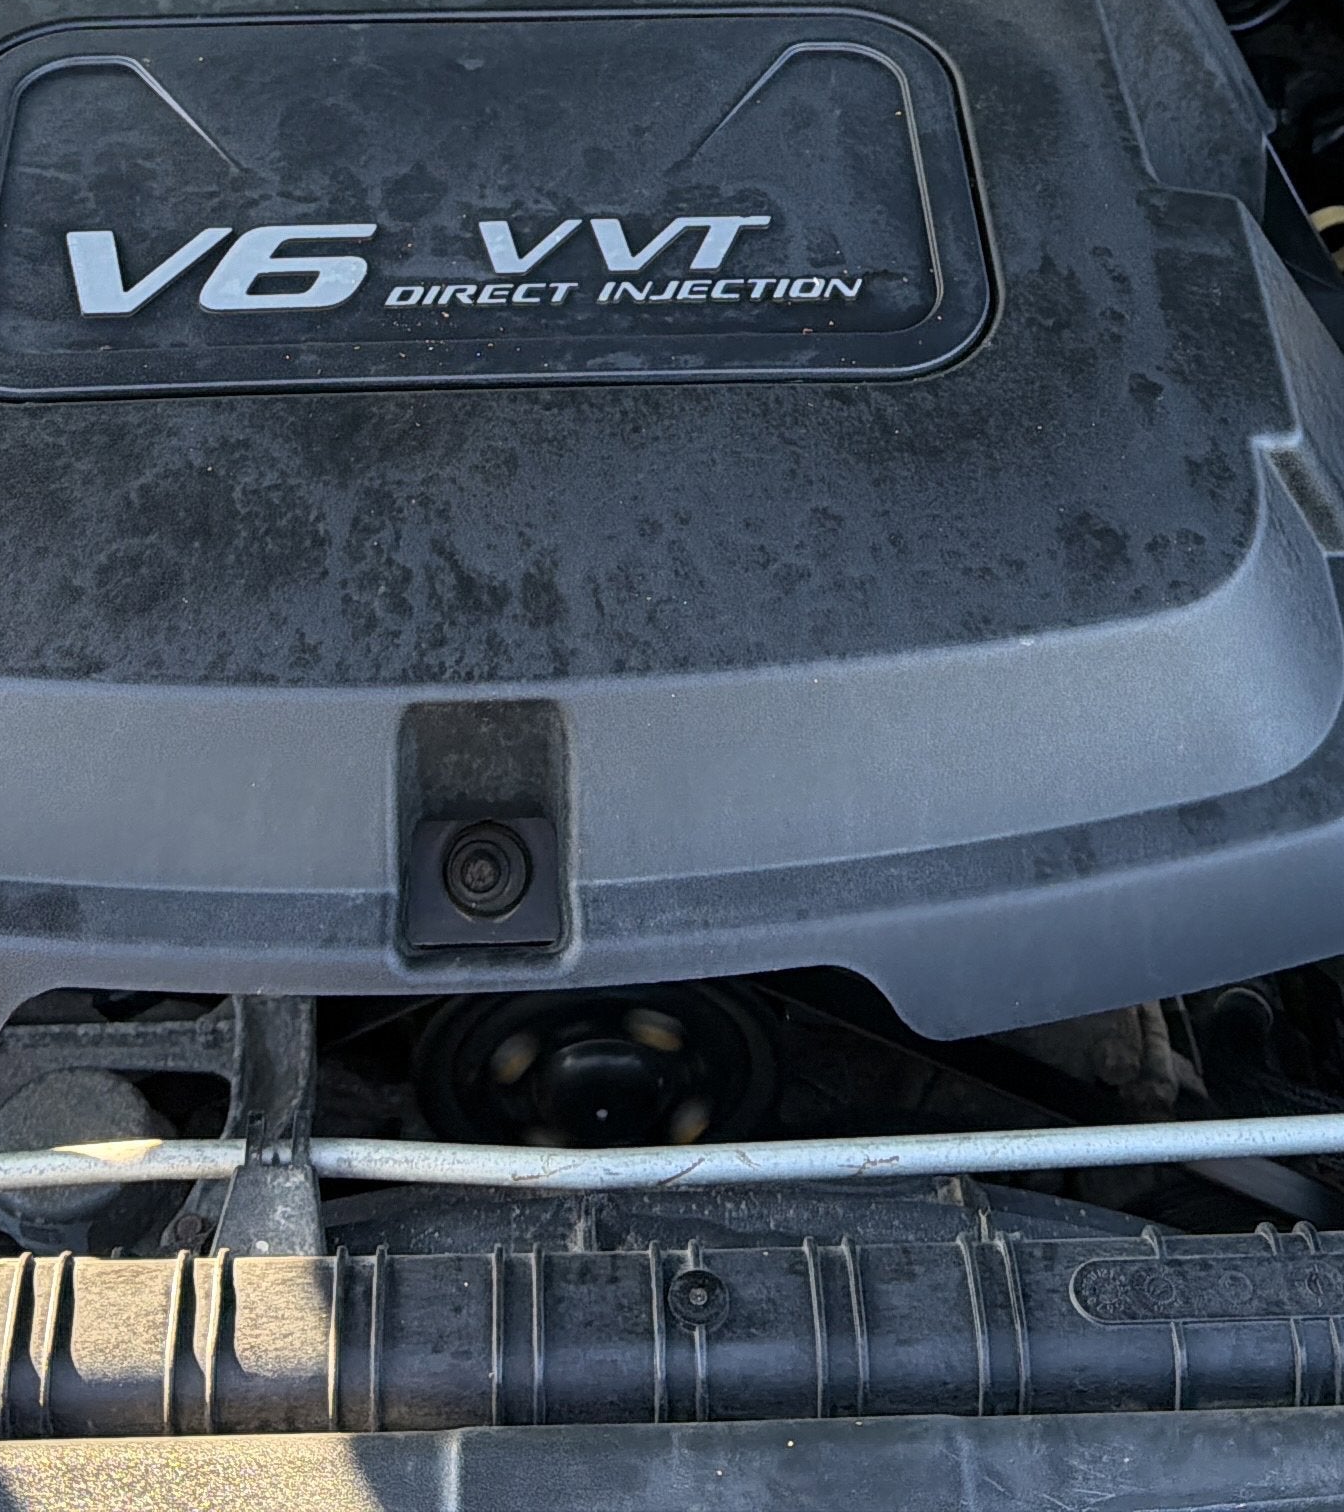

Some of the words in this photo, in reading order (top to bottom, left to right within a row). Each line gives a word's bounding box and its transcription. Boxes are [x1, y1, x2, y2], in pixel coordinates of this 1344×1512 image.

[66, 223, 377, 317] V6
[479, 215, 772, 275] VVT
[384, 281, 579, 308] DIRECT
[598, 278, 864, 305] INJECTION
